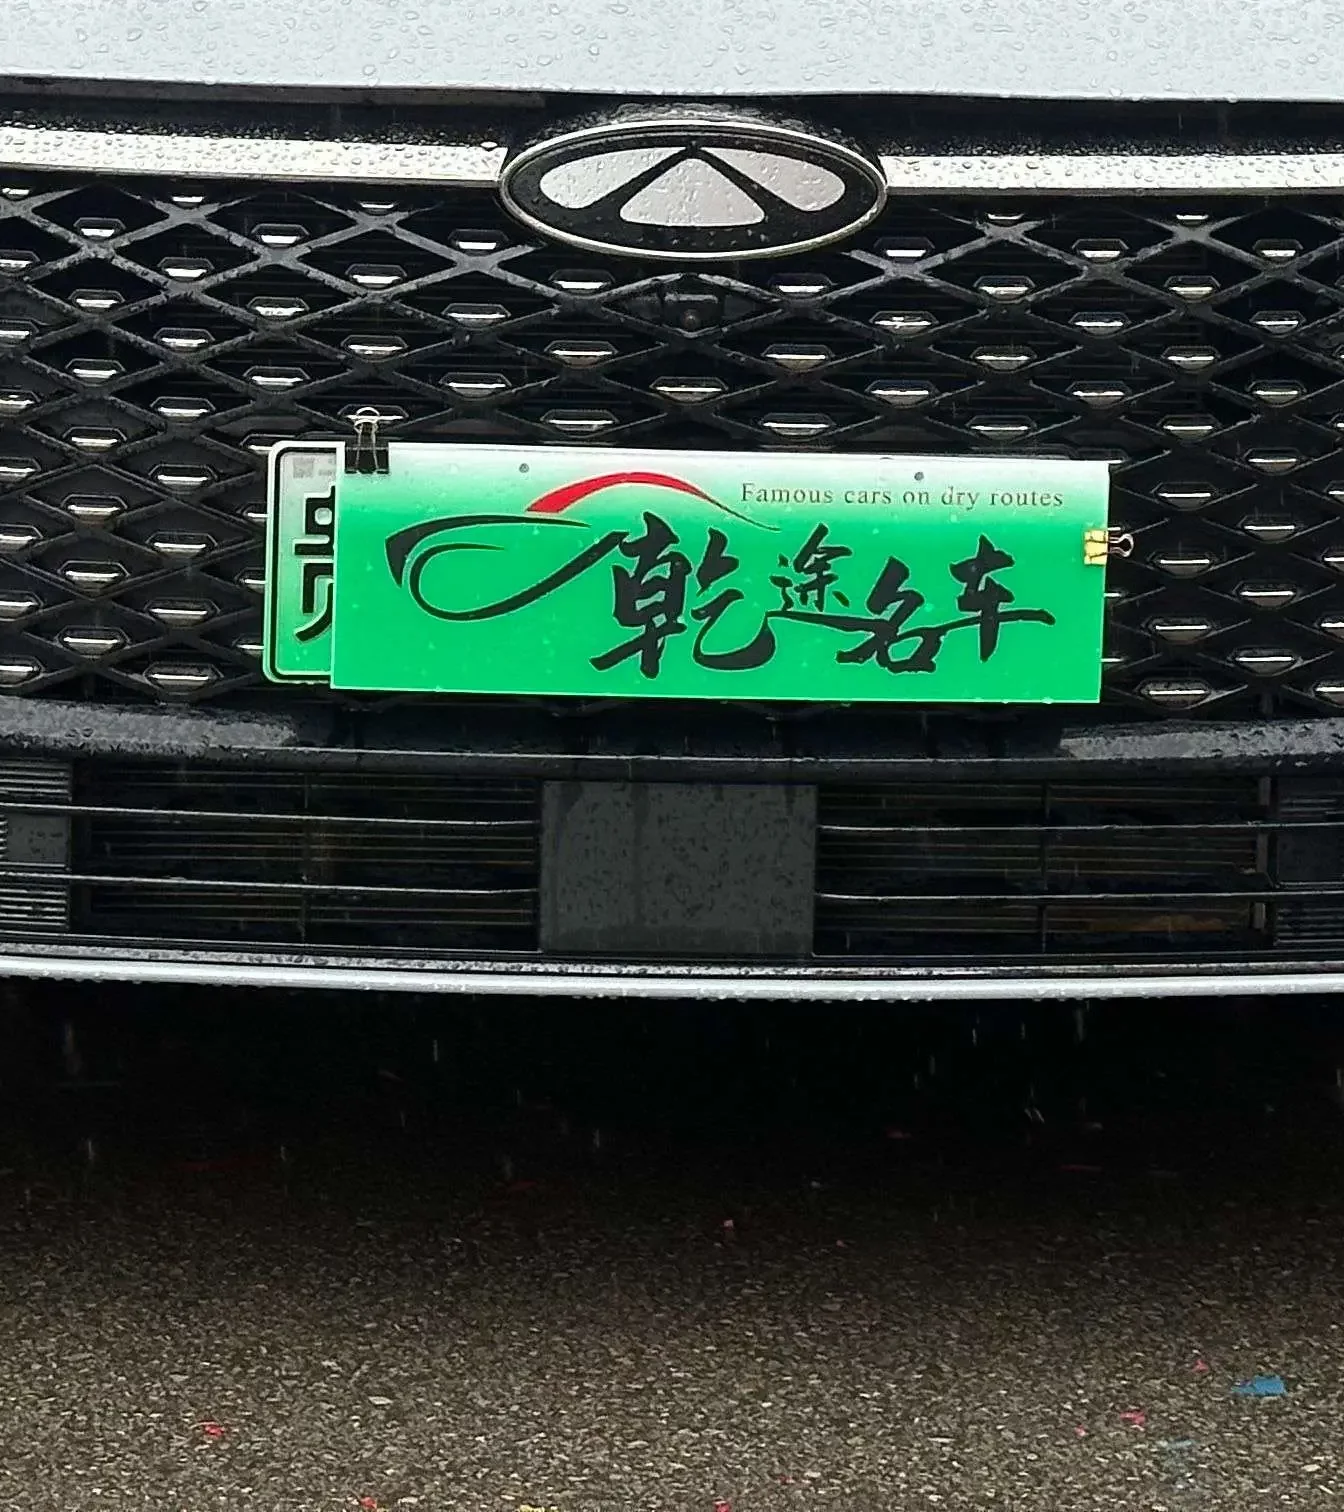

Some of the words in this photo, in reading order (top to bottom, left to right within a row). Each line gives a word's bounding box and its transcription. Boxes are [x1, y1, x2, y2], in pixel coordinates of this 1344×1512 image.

[741, 482, 834, 504] Famous
[844, 488, 892, 505] cars
[902, 490, 931, 505] on
[941, 486, 980, 510] dry
[989, 488, 1064, 506] routes
[589, 510, 1056, 679] 乾途名车
